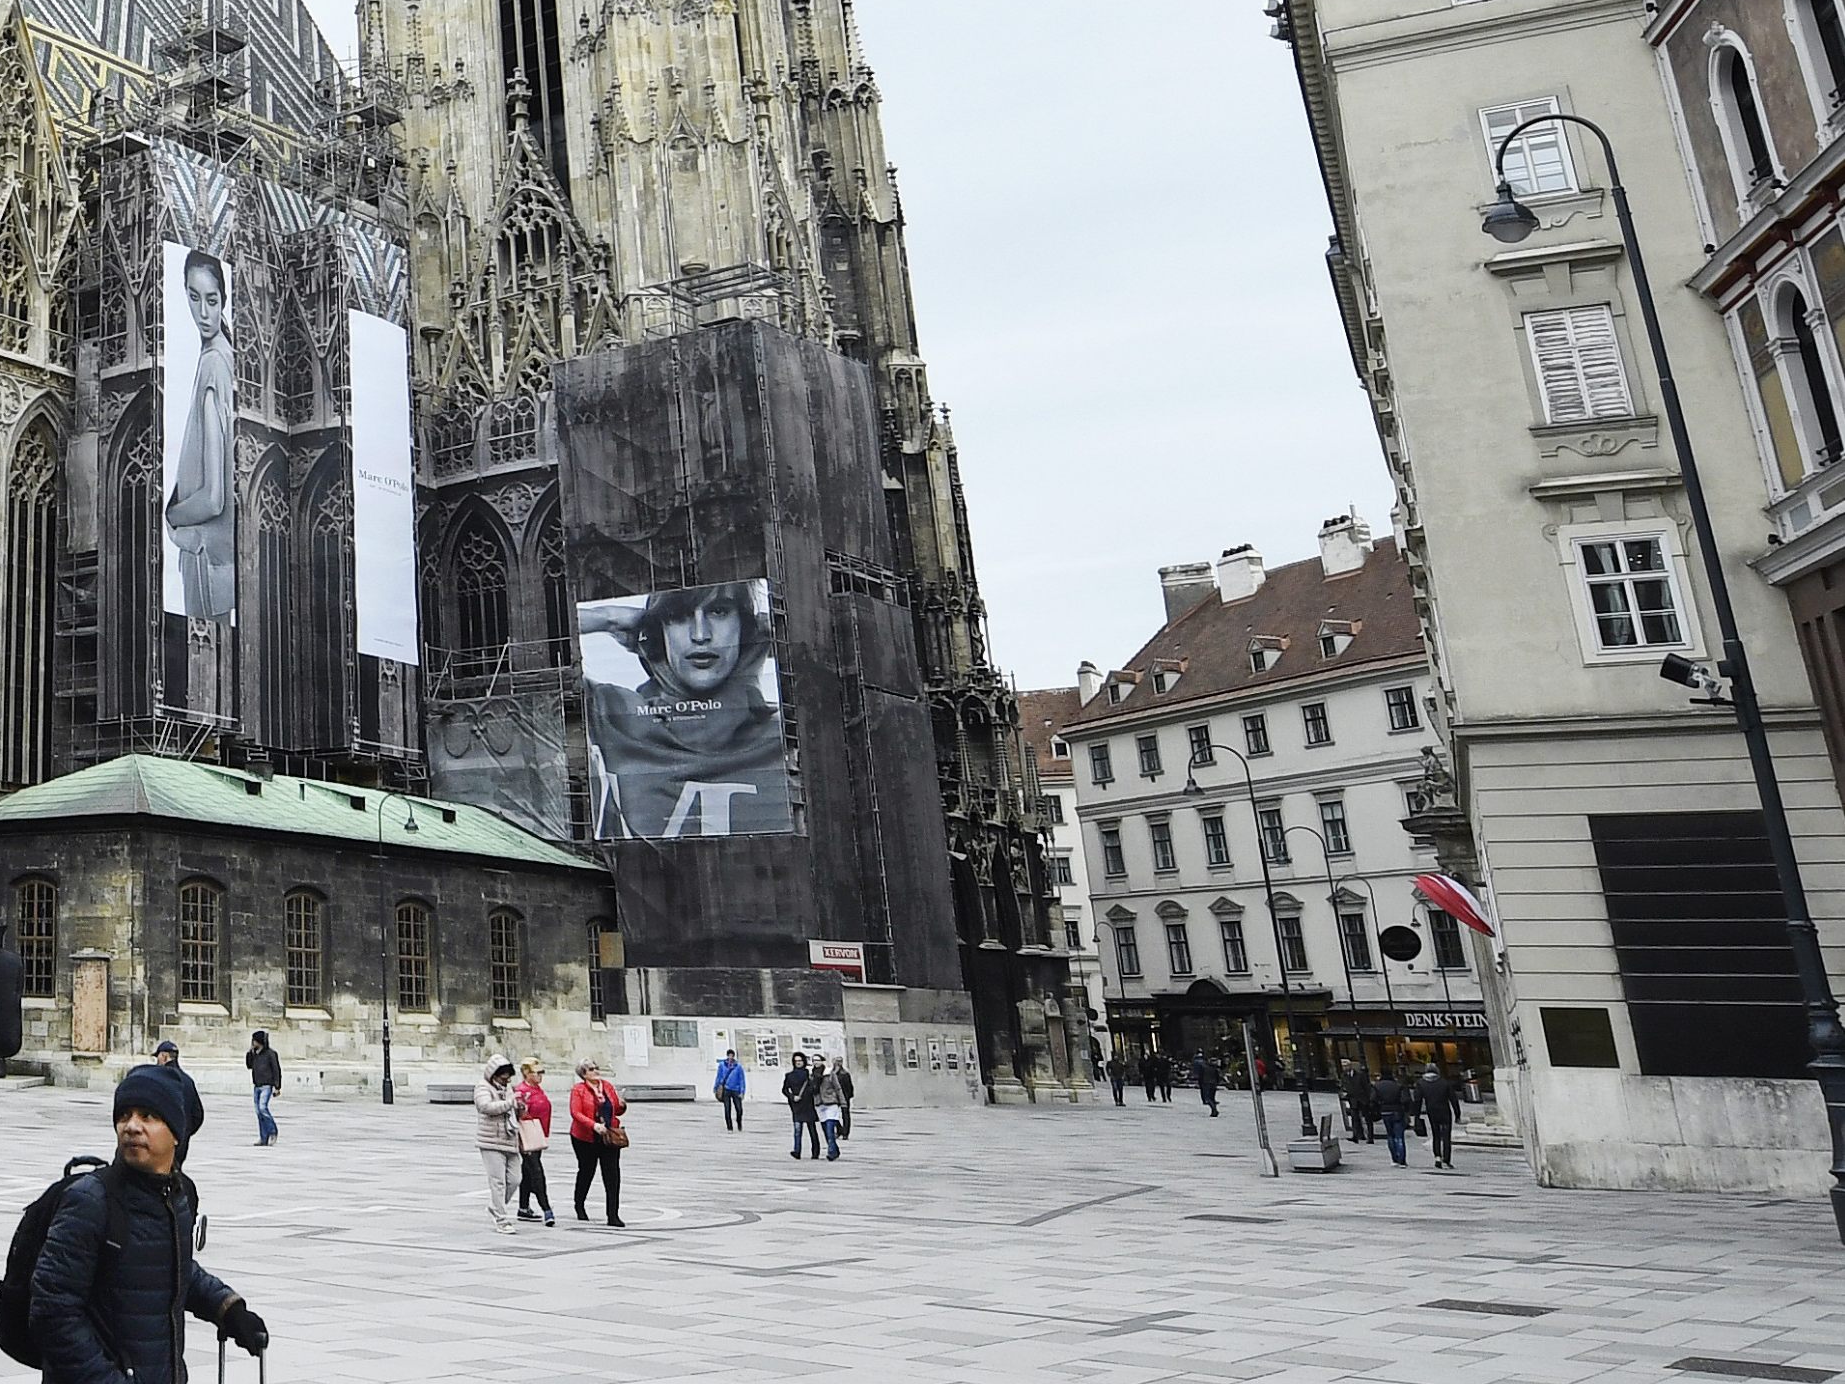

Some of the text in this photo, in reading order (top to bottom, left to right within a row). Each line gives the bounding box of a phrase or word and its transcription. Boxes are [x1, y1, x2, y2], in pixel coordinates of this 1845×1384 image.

[358, 469, 383, 483] Marc
[636, 699, 722, 716] Marc O'Polo
[1404, 1013, 1489, 1028] DENKSTEIN
